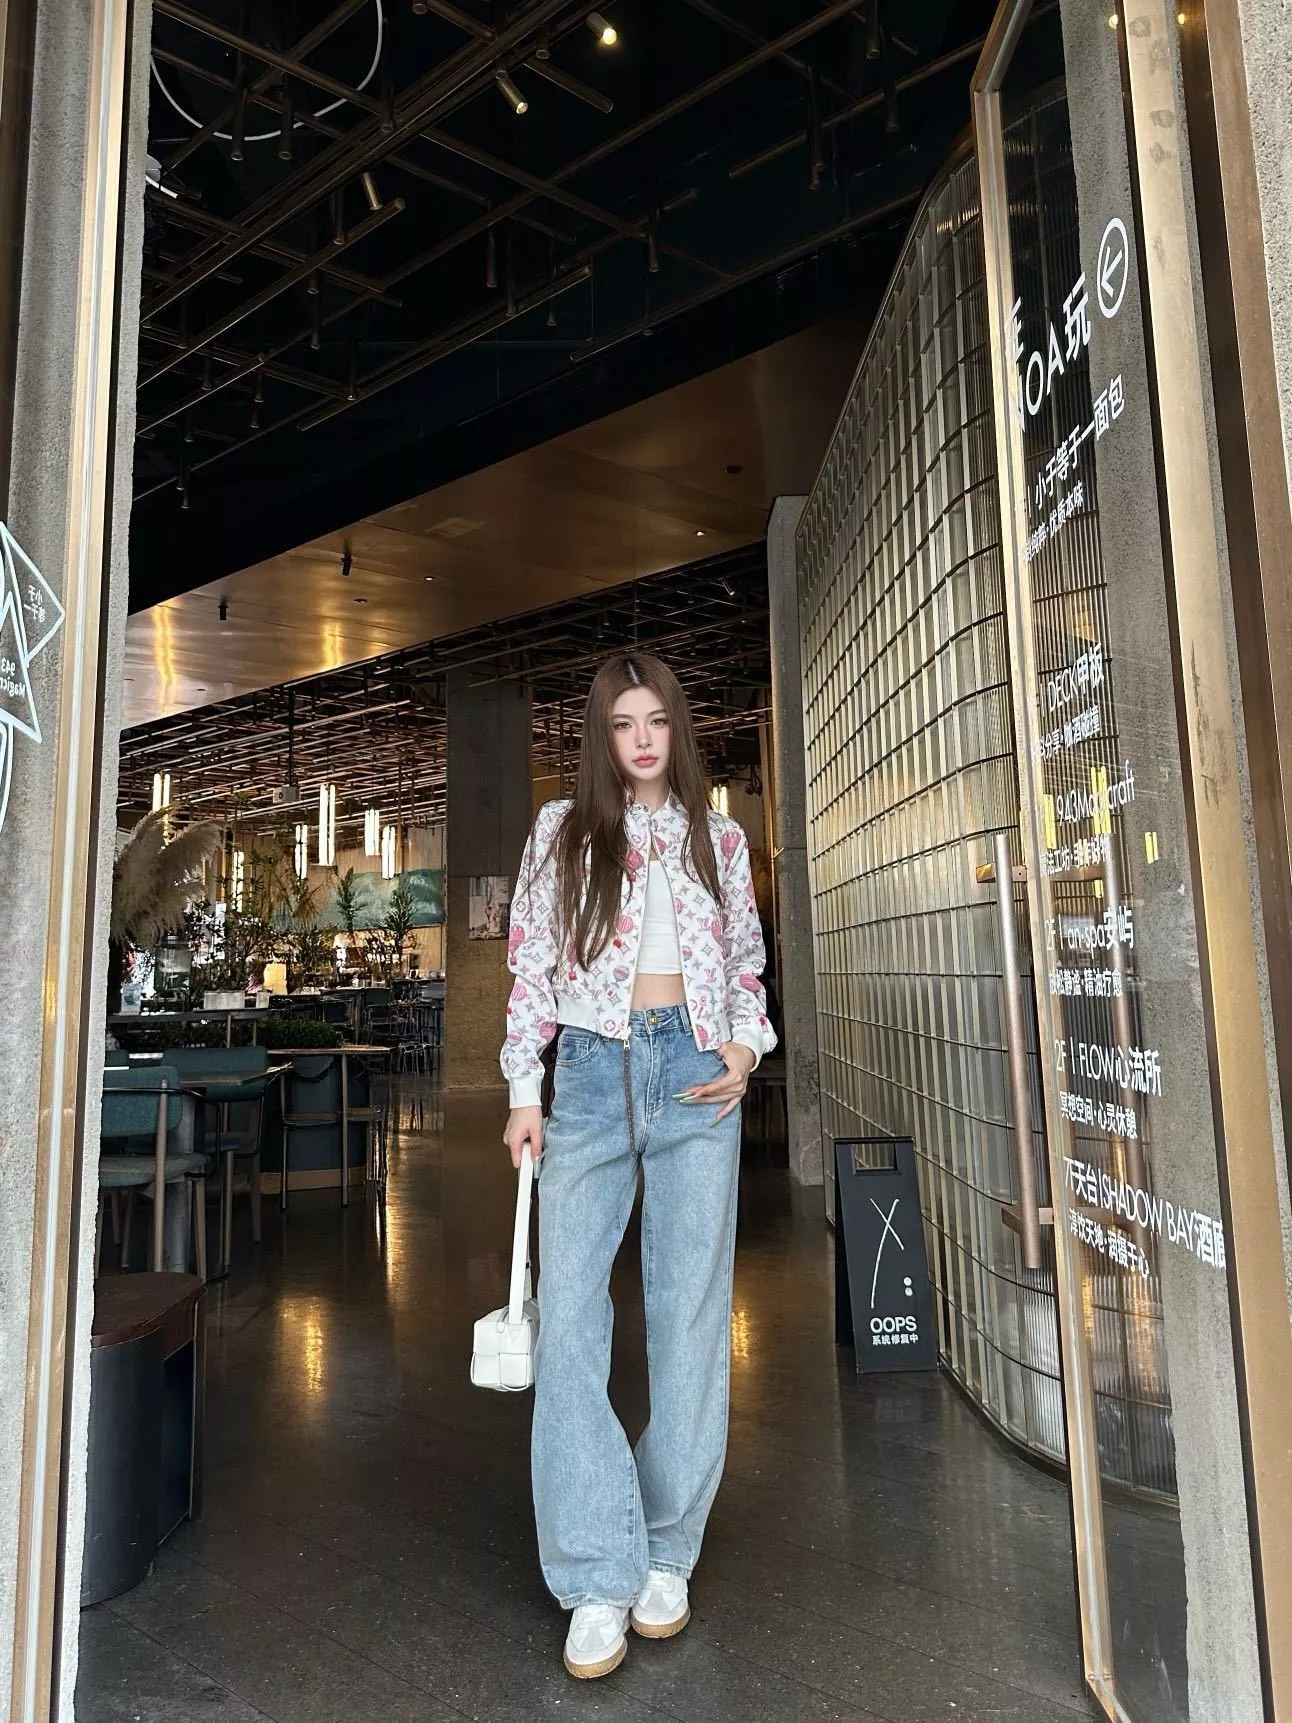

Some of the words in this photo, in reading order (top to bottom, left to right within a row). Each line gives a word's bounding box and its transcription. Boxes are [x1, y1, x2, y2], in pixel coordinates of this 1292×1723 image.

[1035, 373, 1125, 510] 小于等于一面包
[1056, 758, 1135, 826] 943Macraft
[1054, 1038, 1067, 1072] 2F
[1078, 1042, 1162, 1097] FLOW心流所
[1059, 1091, 1138, 1140] 冥想空间·心灵休憩
[1102, 1173, 1163, 1236] SHADOW
[870, 1315, 917, 1333] OOPS
[872, 1333, 919, 1345] 系统修复中
